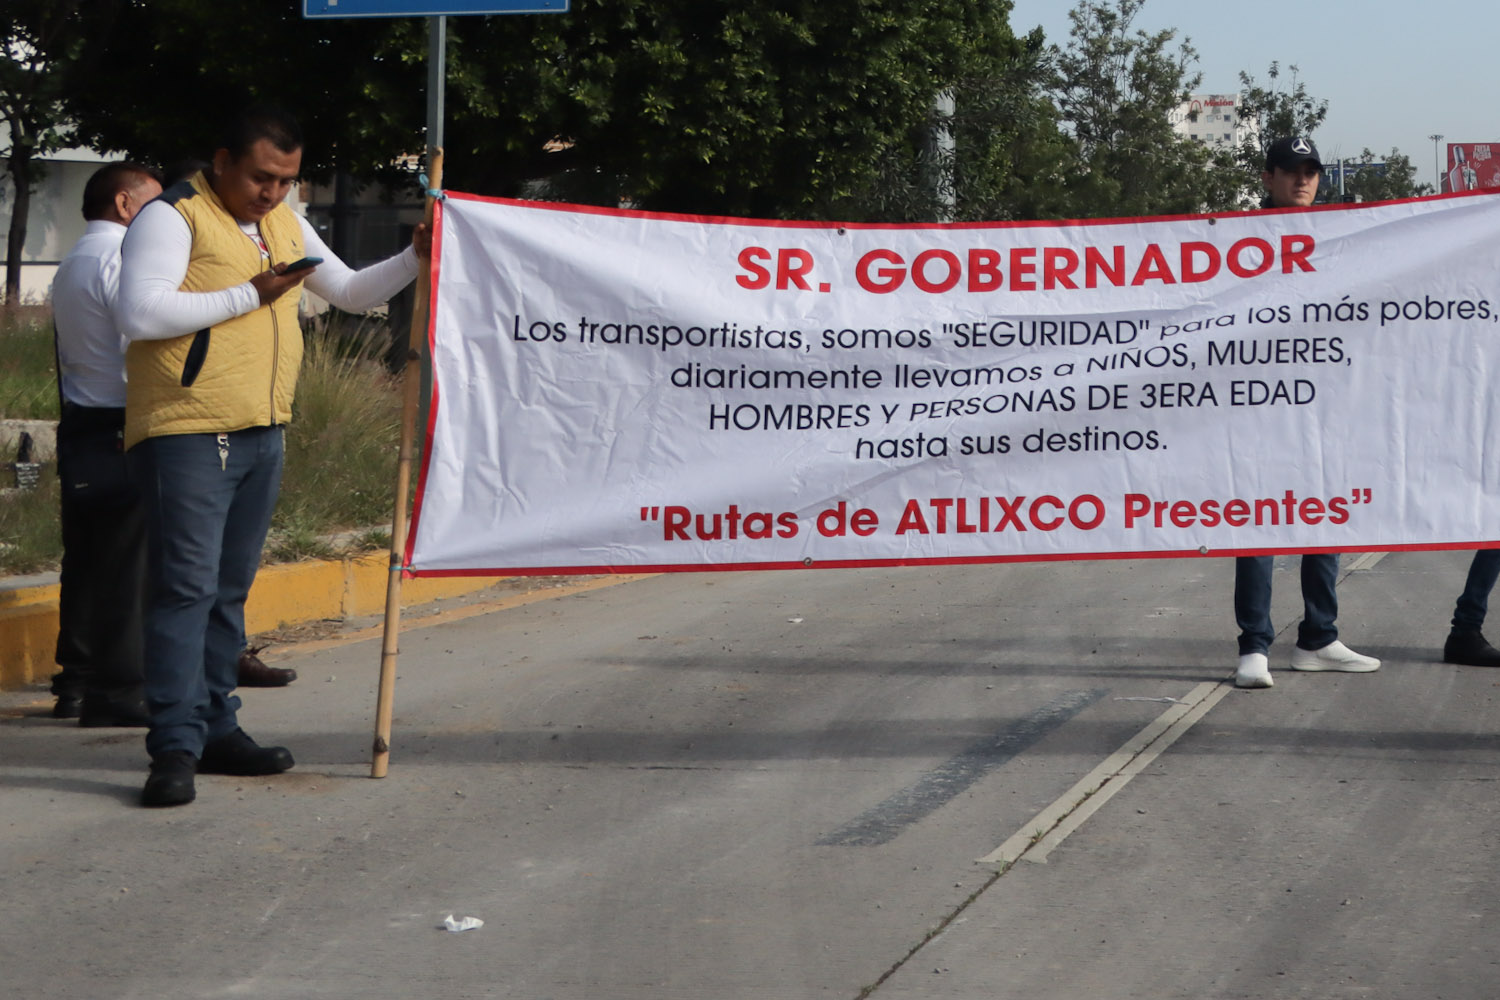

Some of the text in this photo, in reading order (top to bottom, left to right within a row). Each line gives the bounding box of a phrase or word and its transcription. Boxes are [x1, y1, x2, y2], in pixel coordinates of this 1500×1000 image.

[735, 234, 1317, 294] SR. GOBERNADOR
[514, 295, 1499, 353] Los transportistas, somos "SEGURIDAD" para los más pobres,
[671, 337, 1352, 390] diariamente llevamos a NIÑOS, MUJERES,
[709, 379, 1316, 430] HOMBRES Y PERSONAS DE 3ERA EDAD
[856, 426, 1168, 460] hasta sus destinos.
[640, 504, 799, 541] "Rutas
[816, 501, 879, 537] de
[895, 493, 1106, 536] ATLIXCO
